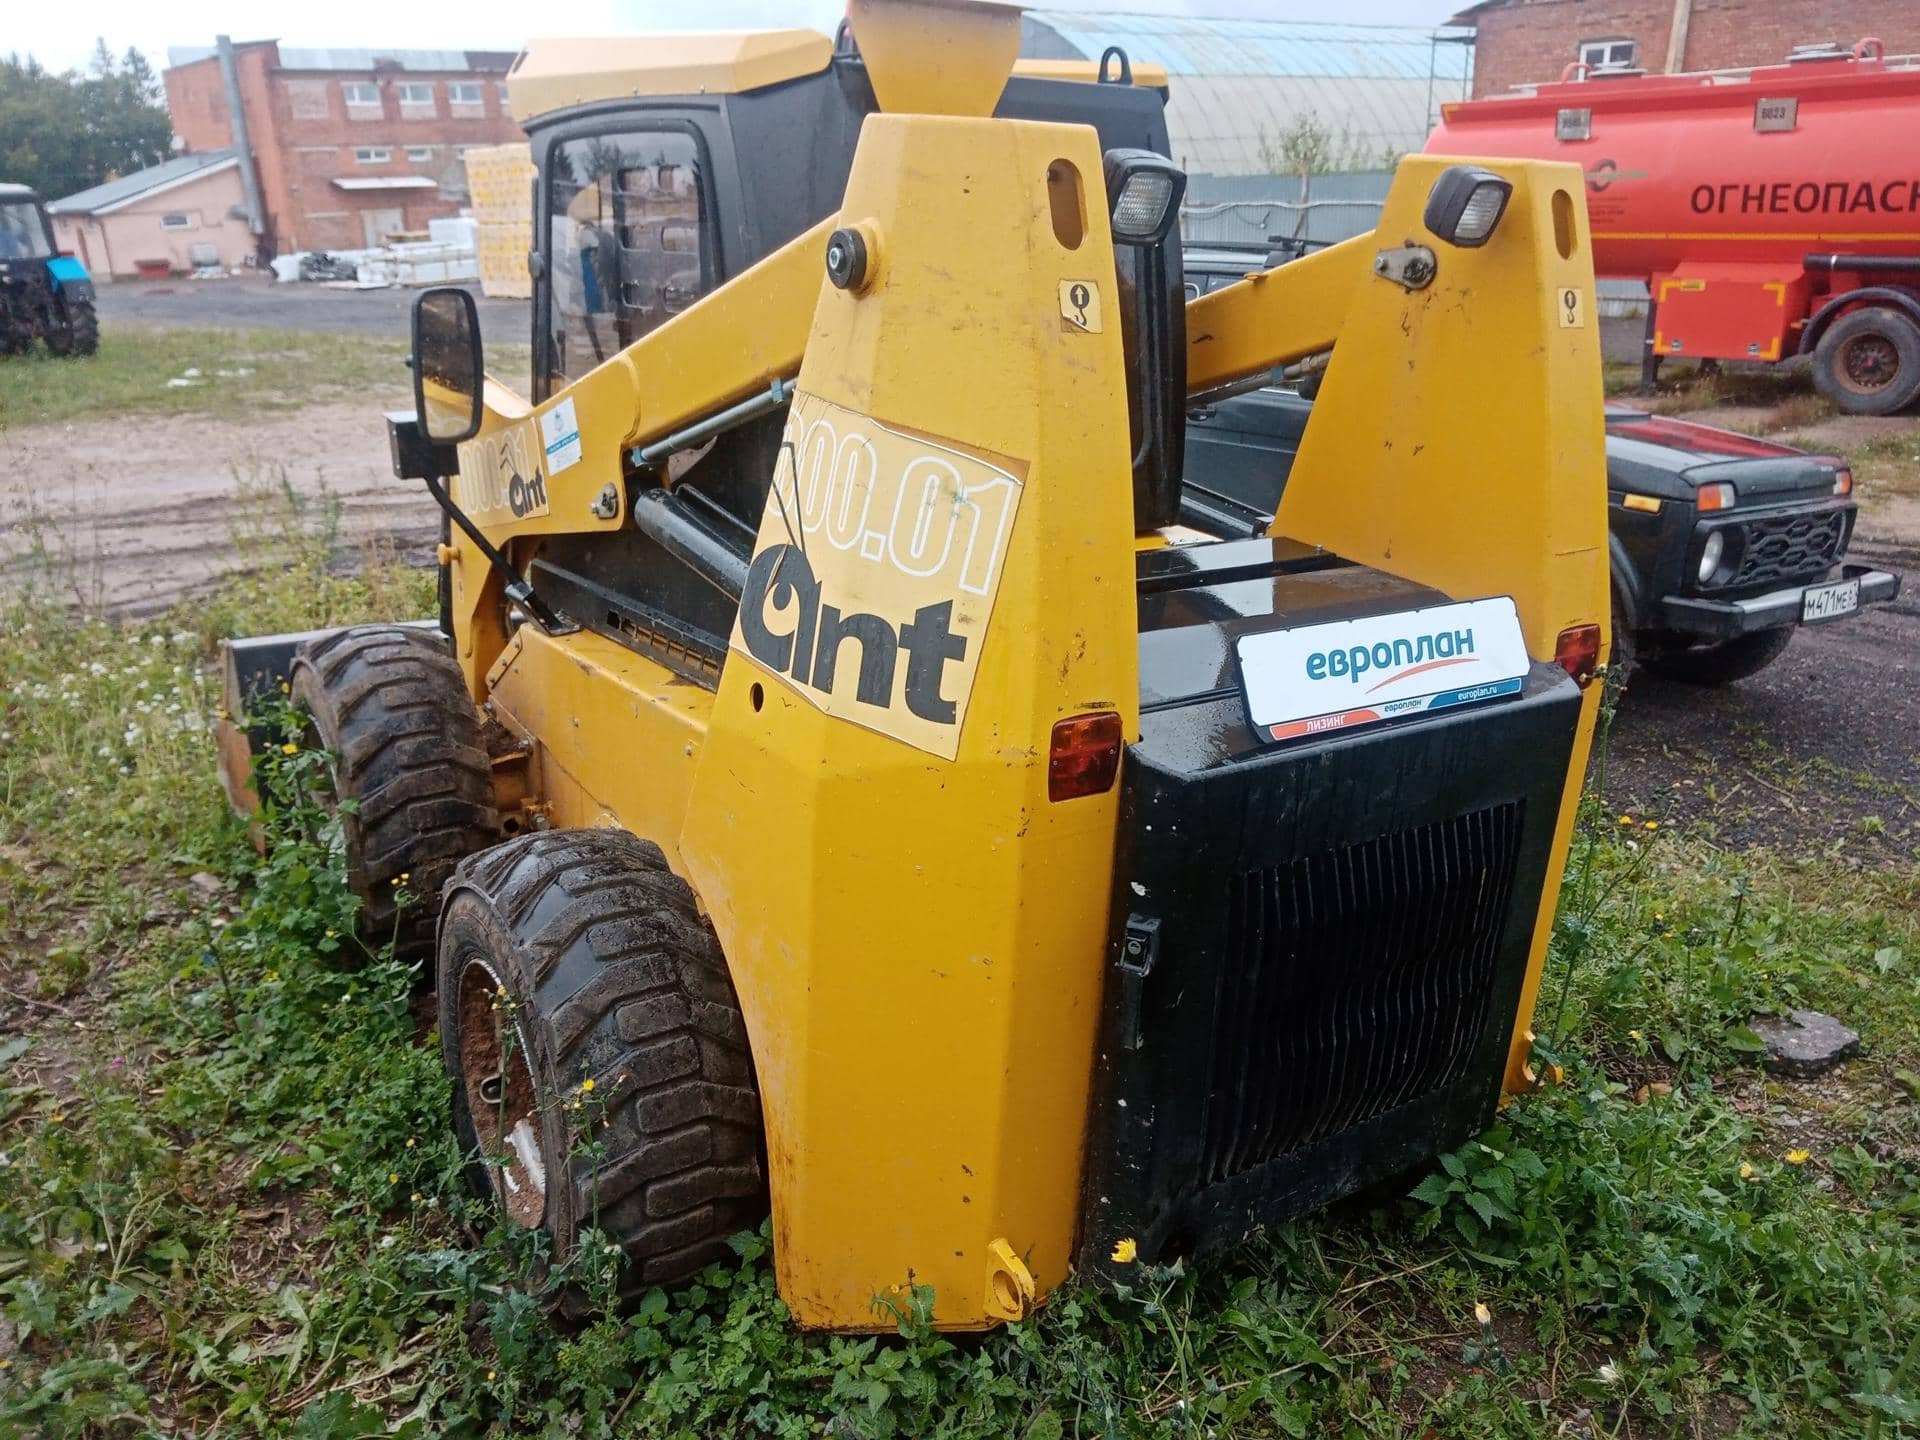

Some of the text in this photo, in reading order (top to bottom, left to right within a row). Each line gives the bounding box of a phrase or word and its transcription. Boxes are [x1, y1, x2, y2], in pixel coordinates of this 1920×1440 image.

[1306, 628, 1475, 684] европлан
[1457, 686, 1498, 701] europlan.ru
[1384, 698, 1422, 713] европлан
[1306, 715, 1346, 732] ЛИЗИНГ
